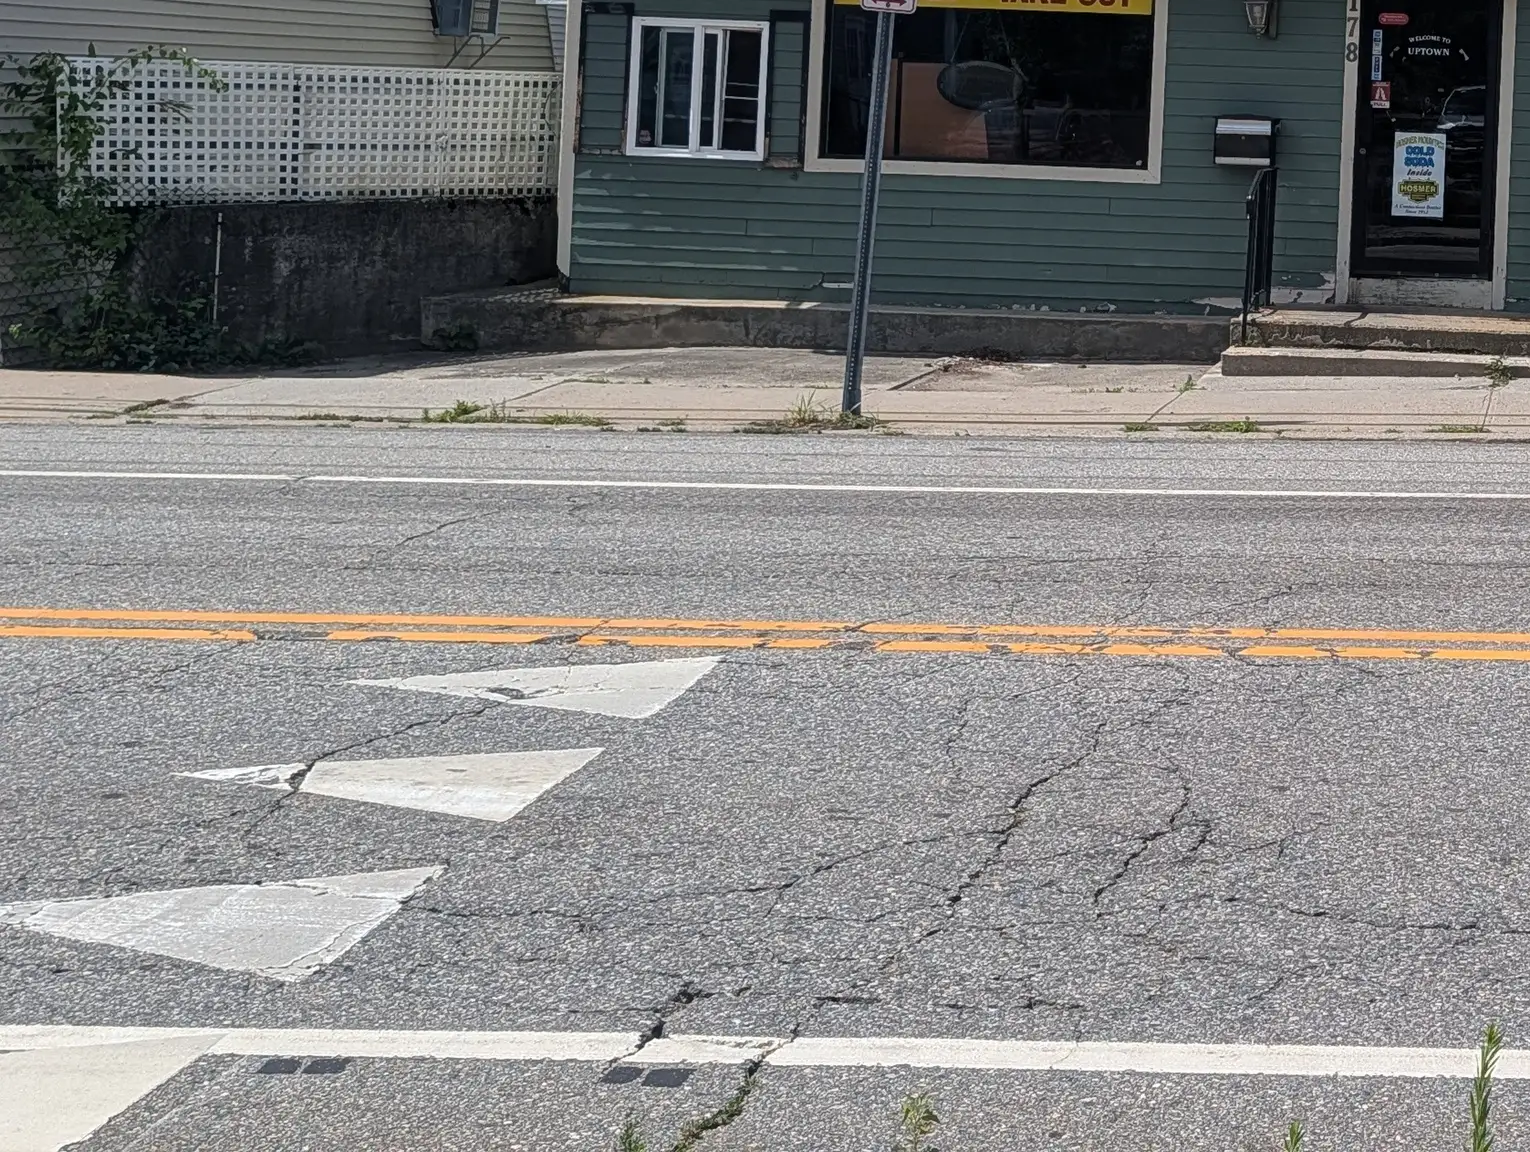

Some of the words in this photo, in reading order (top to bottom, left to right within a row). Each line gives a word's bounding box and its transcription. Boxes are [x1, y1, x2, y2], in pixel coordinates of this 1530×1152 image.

[1408, 35, 1441, 43] WELCOME
[1442, 37, 1451, 45] TO
[1408, 47, 1450, 56] UPTOWN
[1405, 145, 1435, 157] COLD
[1404, 156, 1435, 168] SODA
[1407, 168, 1432, 176] Inside
[1400, 184, 1437, 193] HOSMER
